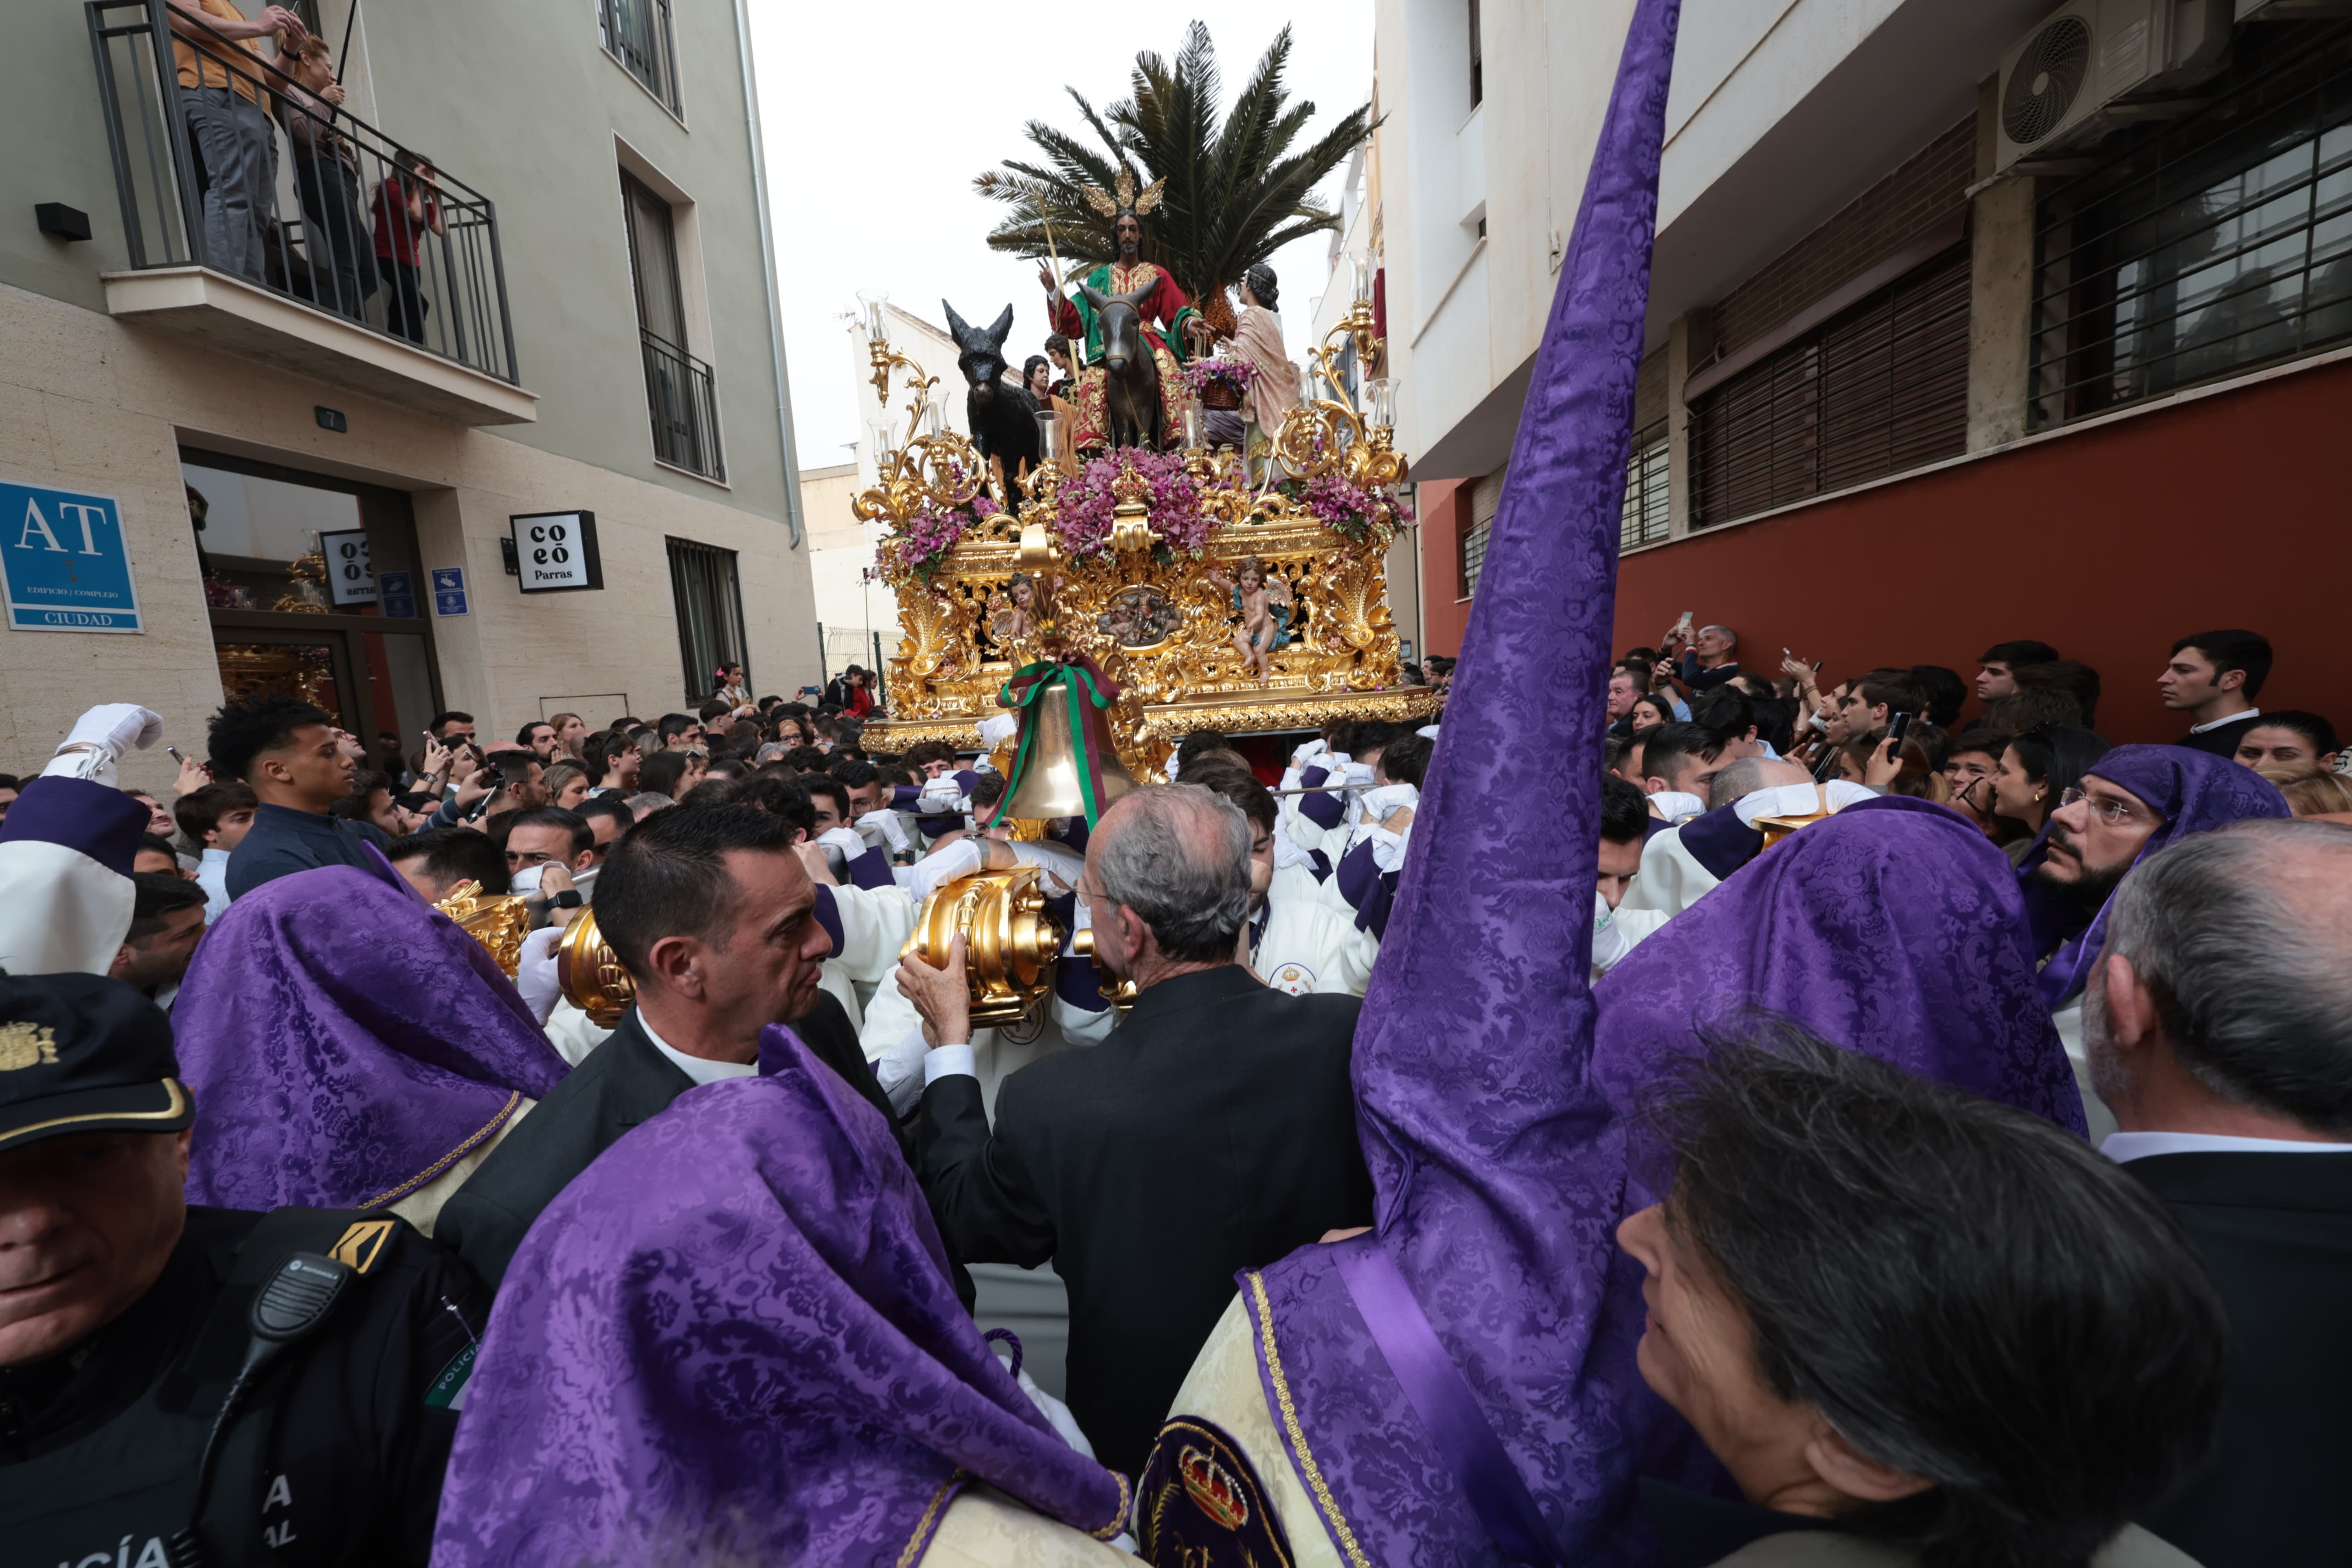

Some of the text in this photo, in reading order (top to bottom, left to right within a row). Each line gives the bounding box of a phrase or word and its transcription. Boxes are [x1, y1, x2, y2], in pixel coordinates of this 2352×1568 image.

[326, 411, 335, 427] 7
[14, 497, 107, 556] AT
[530, 525, 566, 543] co
[534, 570, 573, 580] Parras
[27, 586, 68, 595] EDIFICIO
[74, 589, 118, 599] COMPLEJO
[44, 612, 113, 626] CIUDAD
